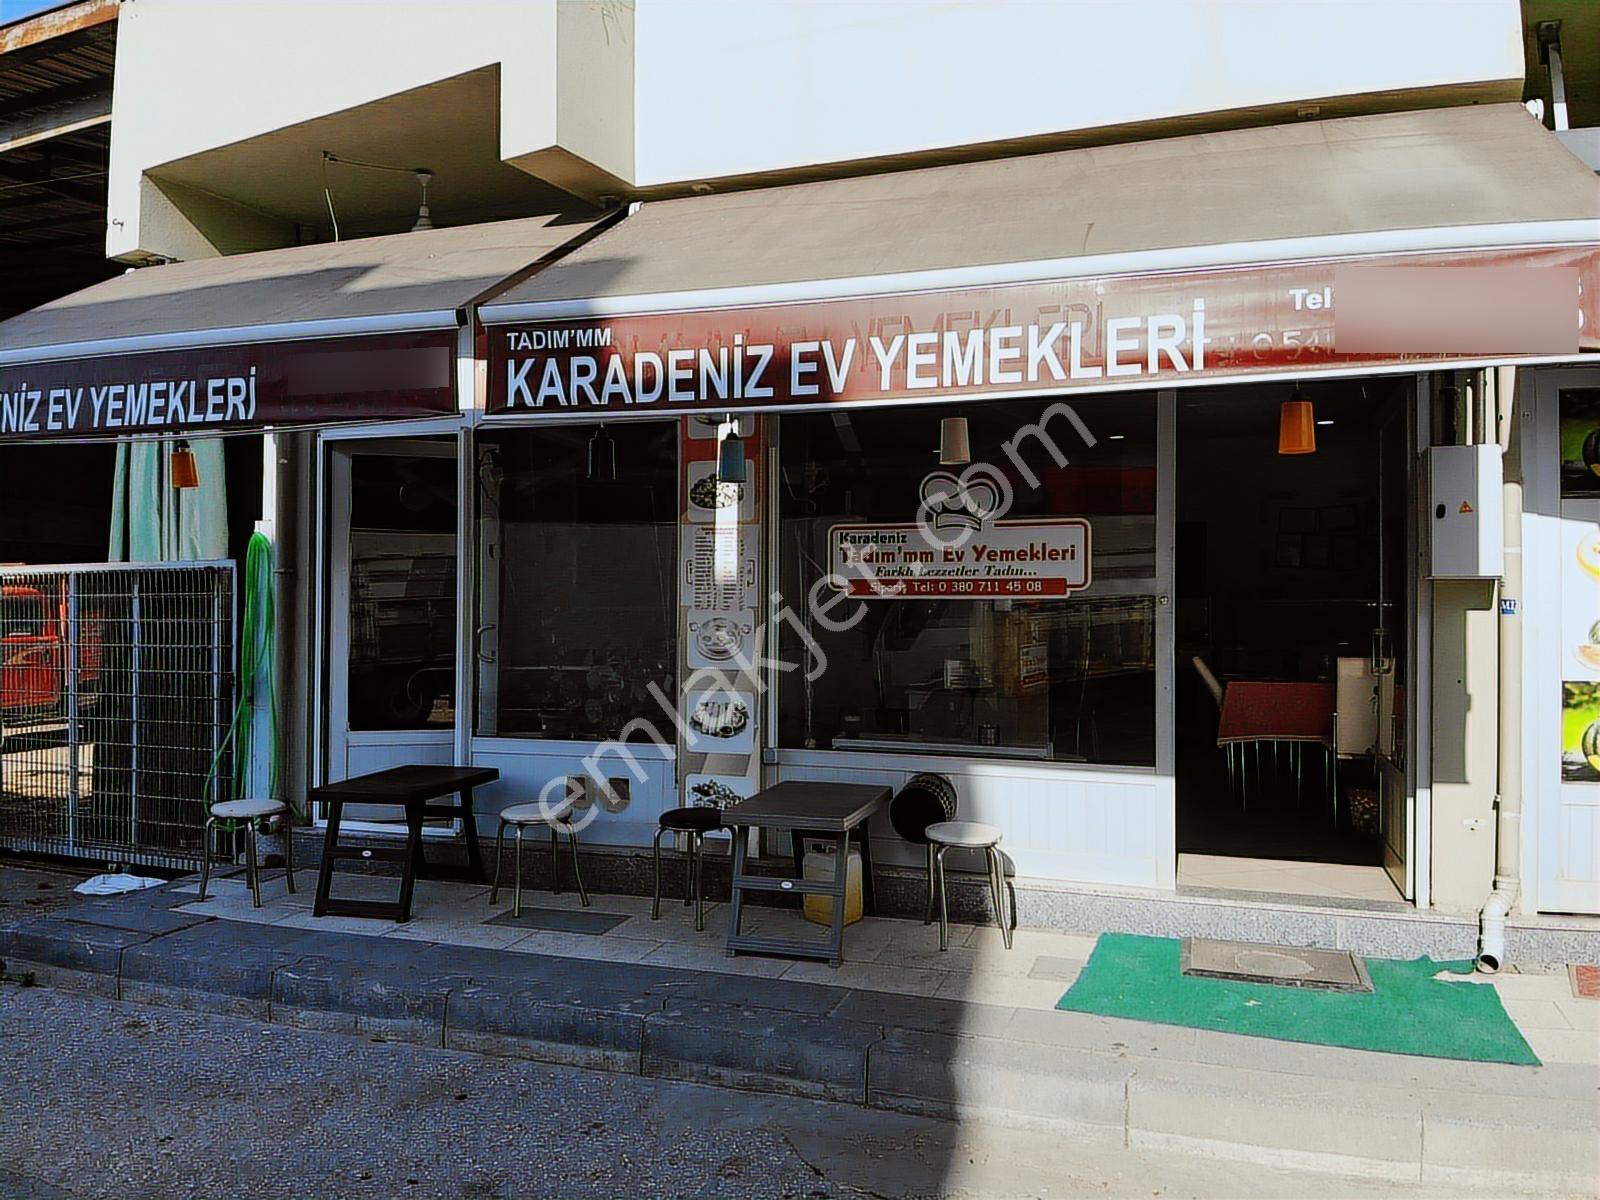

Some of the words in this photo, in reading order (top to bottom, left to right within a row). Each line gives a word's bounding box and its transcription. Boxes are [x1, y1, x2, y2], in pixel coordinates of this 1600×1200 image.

[507, 327, 611, 350] TADIM'MM
[507, 335, 774, 407] KARADENİZ
[790, 338, 856, 396] EV
[869, 298, 1206, 391] YEMEKLERİ
[0, 382, 41, 433] NİZ
[47, 388, 84, 430] EV
[90, 366, 257, 428] YEMEKLERİ
[839, 532, 908, 545] Karadeniz
[942, 545, 965, 563] Ev
[972, 542, 1076, 563] Yemekleri
[912, 581, 935, 592] Tel:
[938, 581, 947, 592] 0
[951, 581, 974, 592] 380
[978, 581, 1000, 592] 711
[1005, 581, 1021, 592] 45
[1026, 581, 1043, 592] 08
